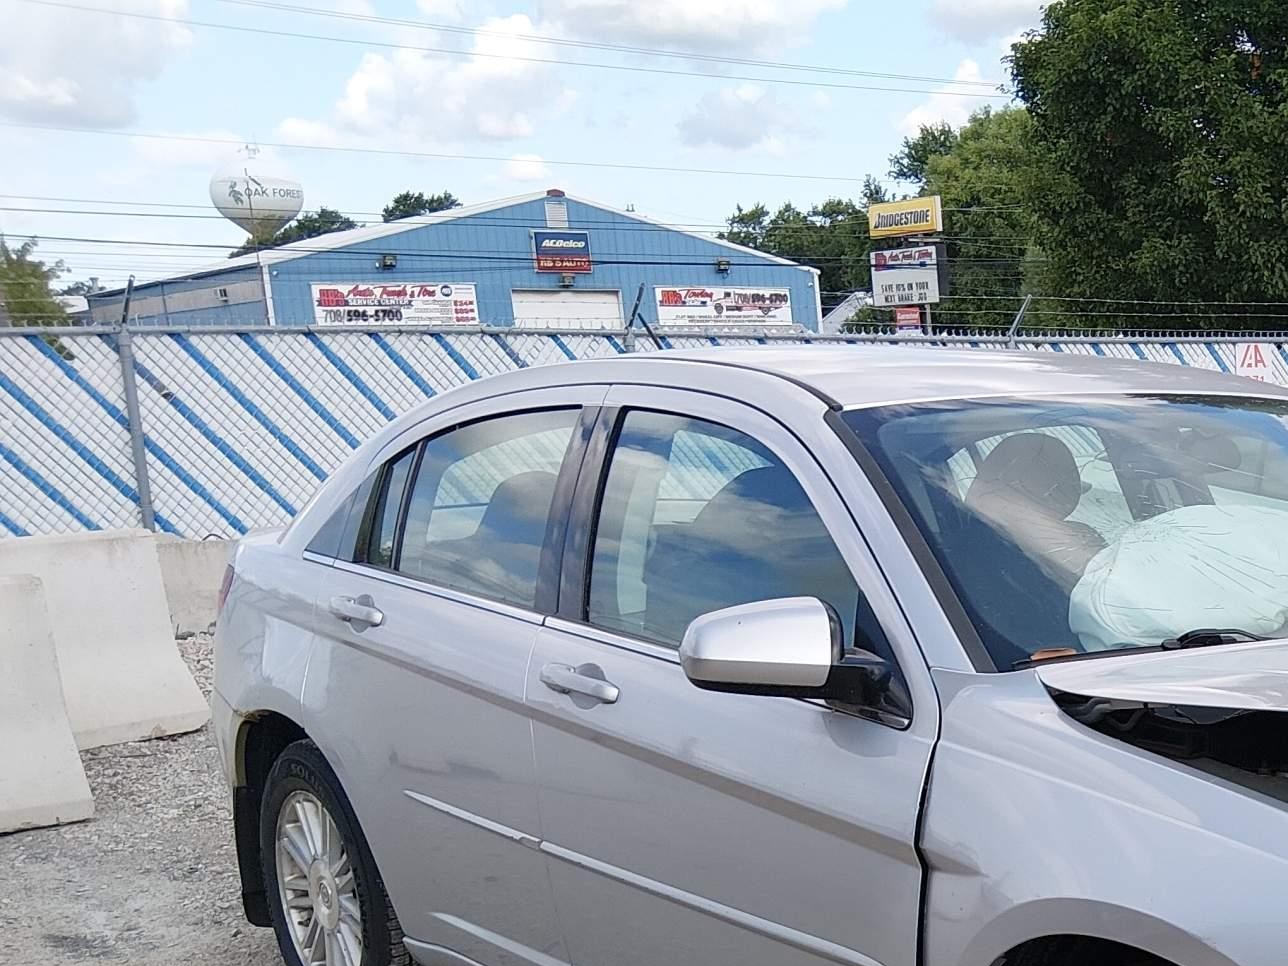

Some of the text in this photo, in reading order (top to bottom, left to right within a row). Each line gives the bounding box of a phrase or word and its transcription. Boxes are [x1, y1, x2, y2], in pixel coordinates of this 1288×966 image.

[244, 188, 269, 198] OAK
[873, 209, 930, 229] BRIDGESTONE
[541, 239, 586, 248] ACDelco
[881, 284, 894, 293] SAVE
[915, 281, 929, 291] YOUR
[348, 298, 379, 306] SERVICE
[884, 294, 896, 303] NEXT
